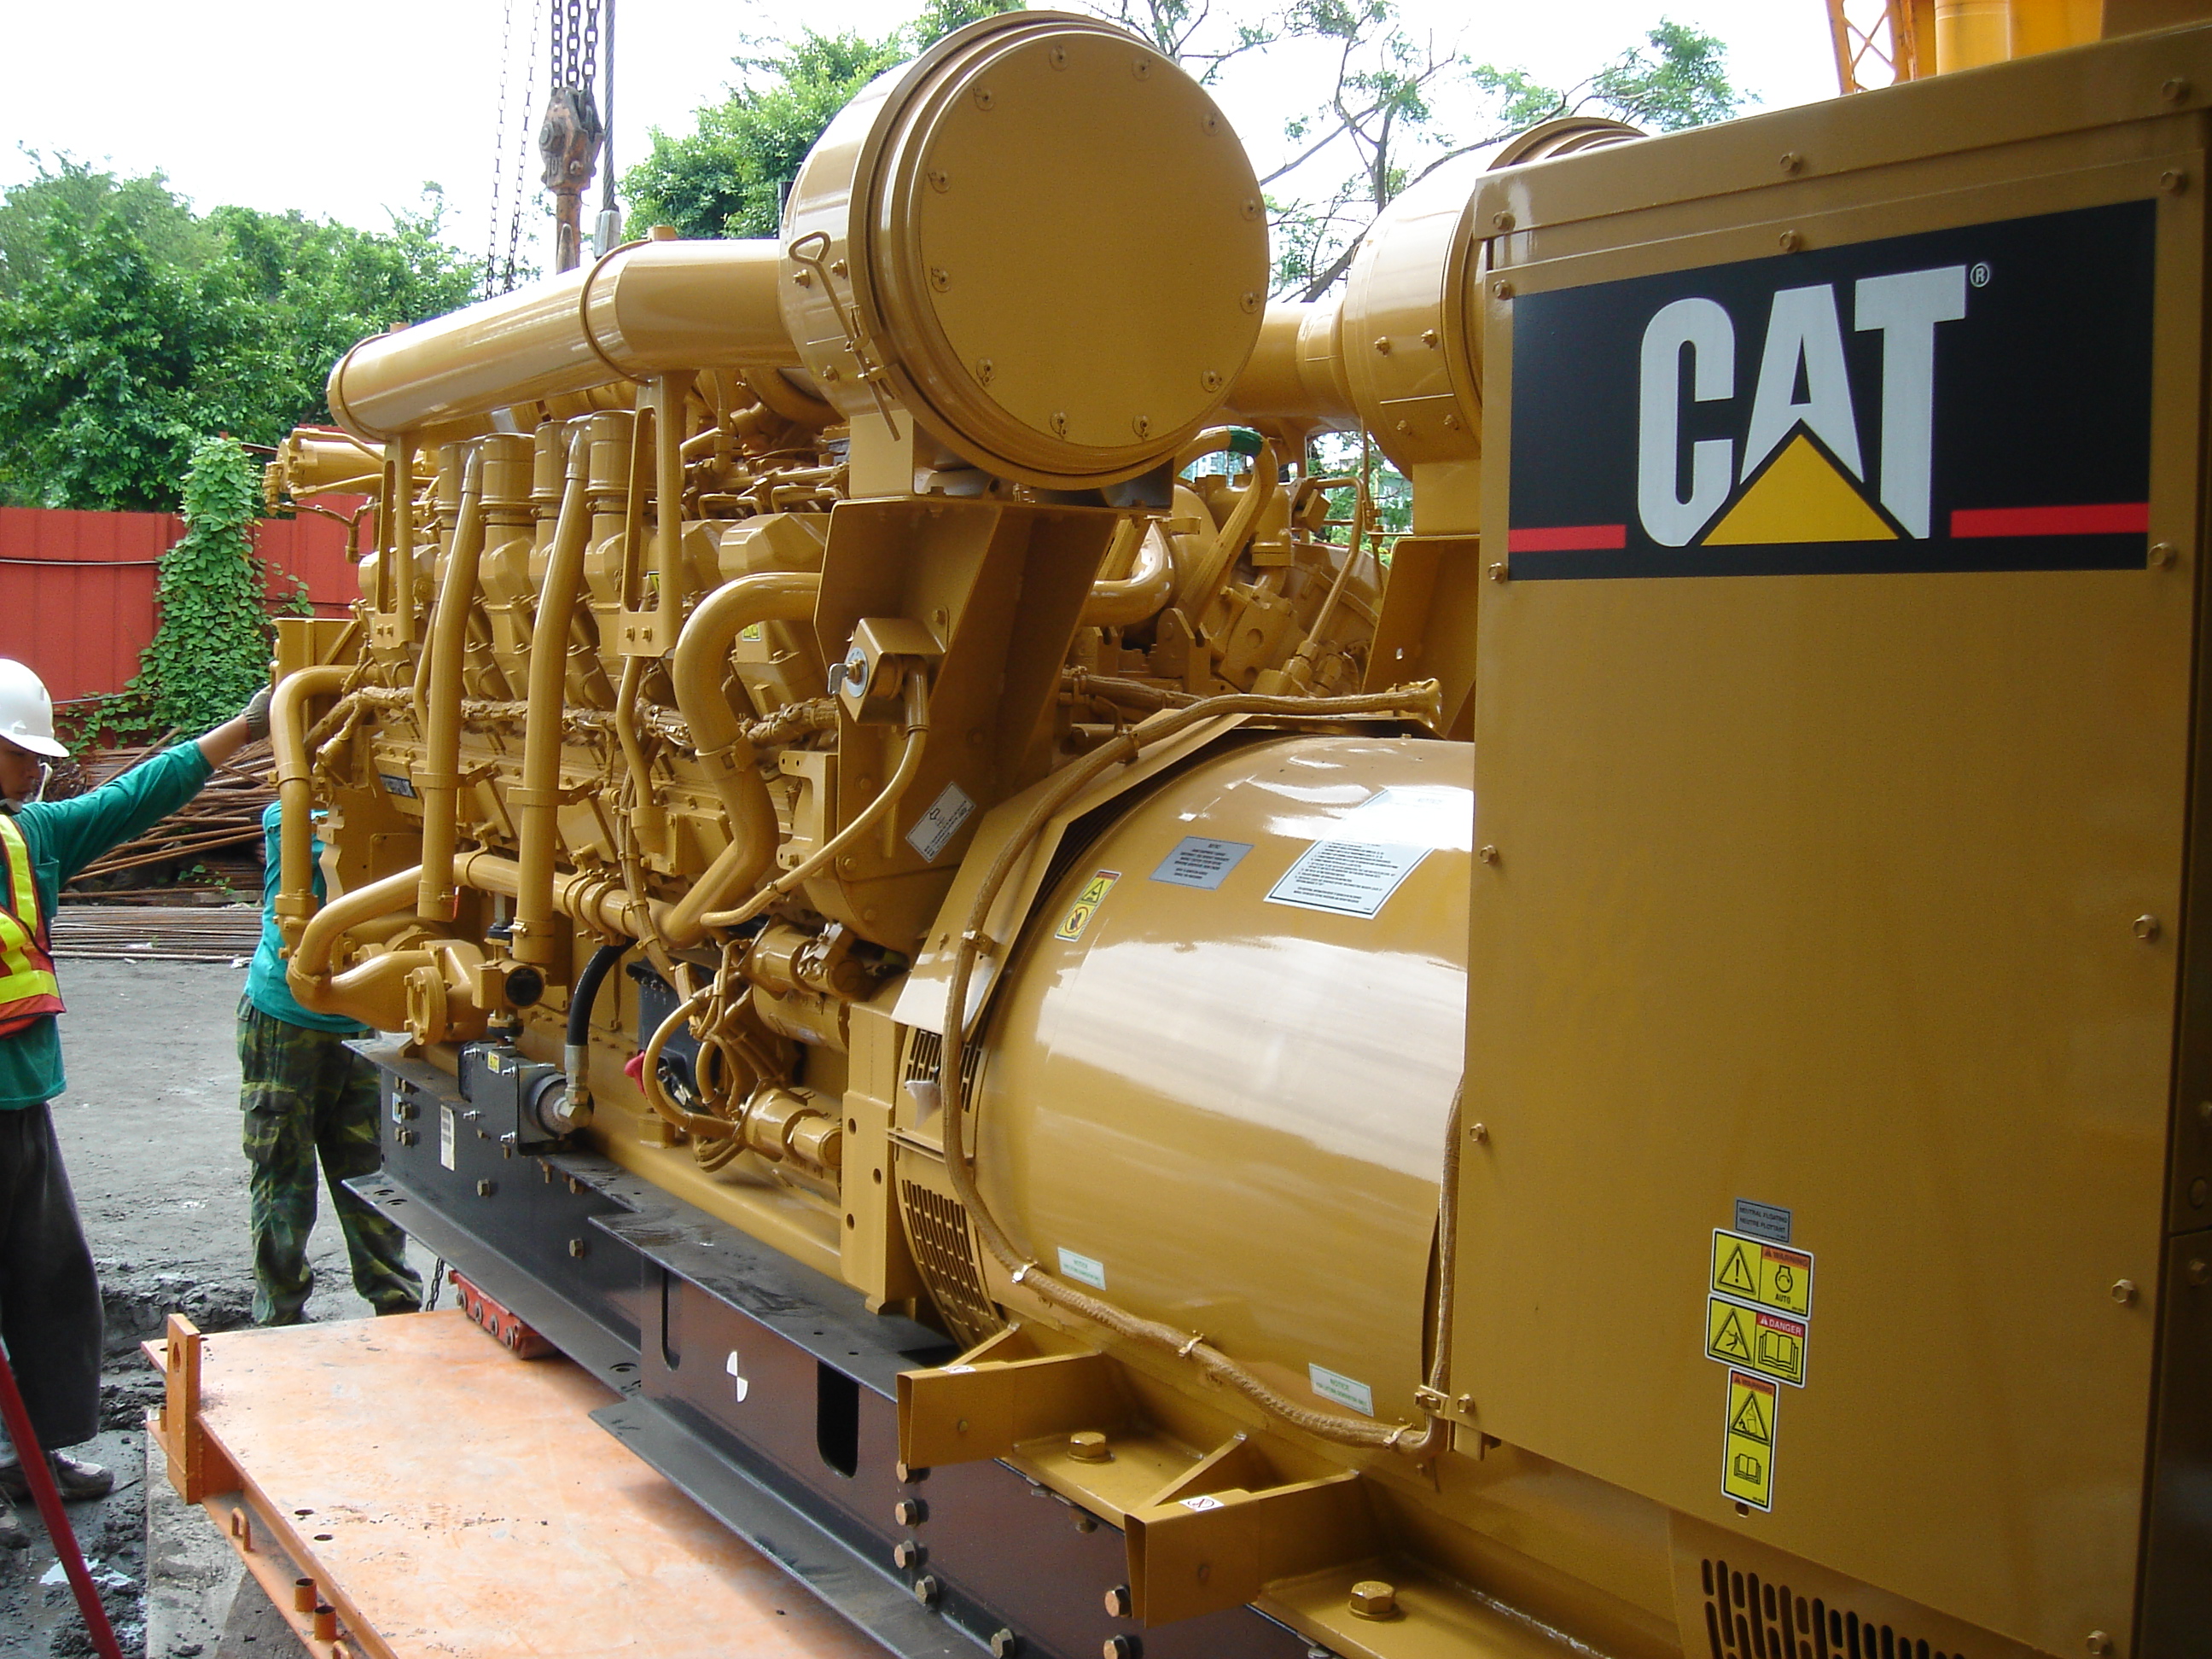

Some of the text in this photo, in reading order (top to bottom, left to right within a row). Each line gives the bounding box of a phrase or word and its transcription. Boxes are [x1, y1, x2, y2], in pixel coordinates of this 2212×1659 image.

[1638, 265, 1966, 547] CAT
[1773, 1252, 1808, 1268] WARNING
[1775, 1293, 1791, 1305] AUTO
[1768, 1318, 1802, 1336] DANGER
